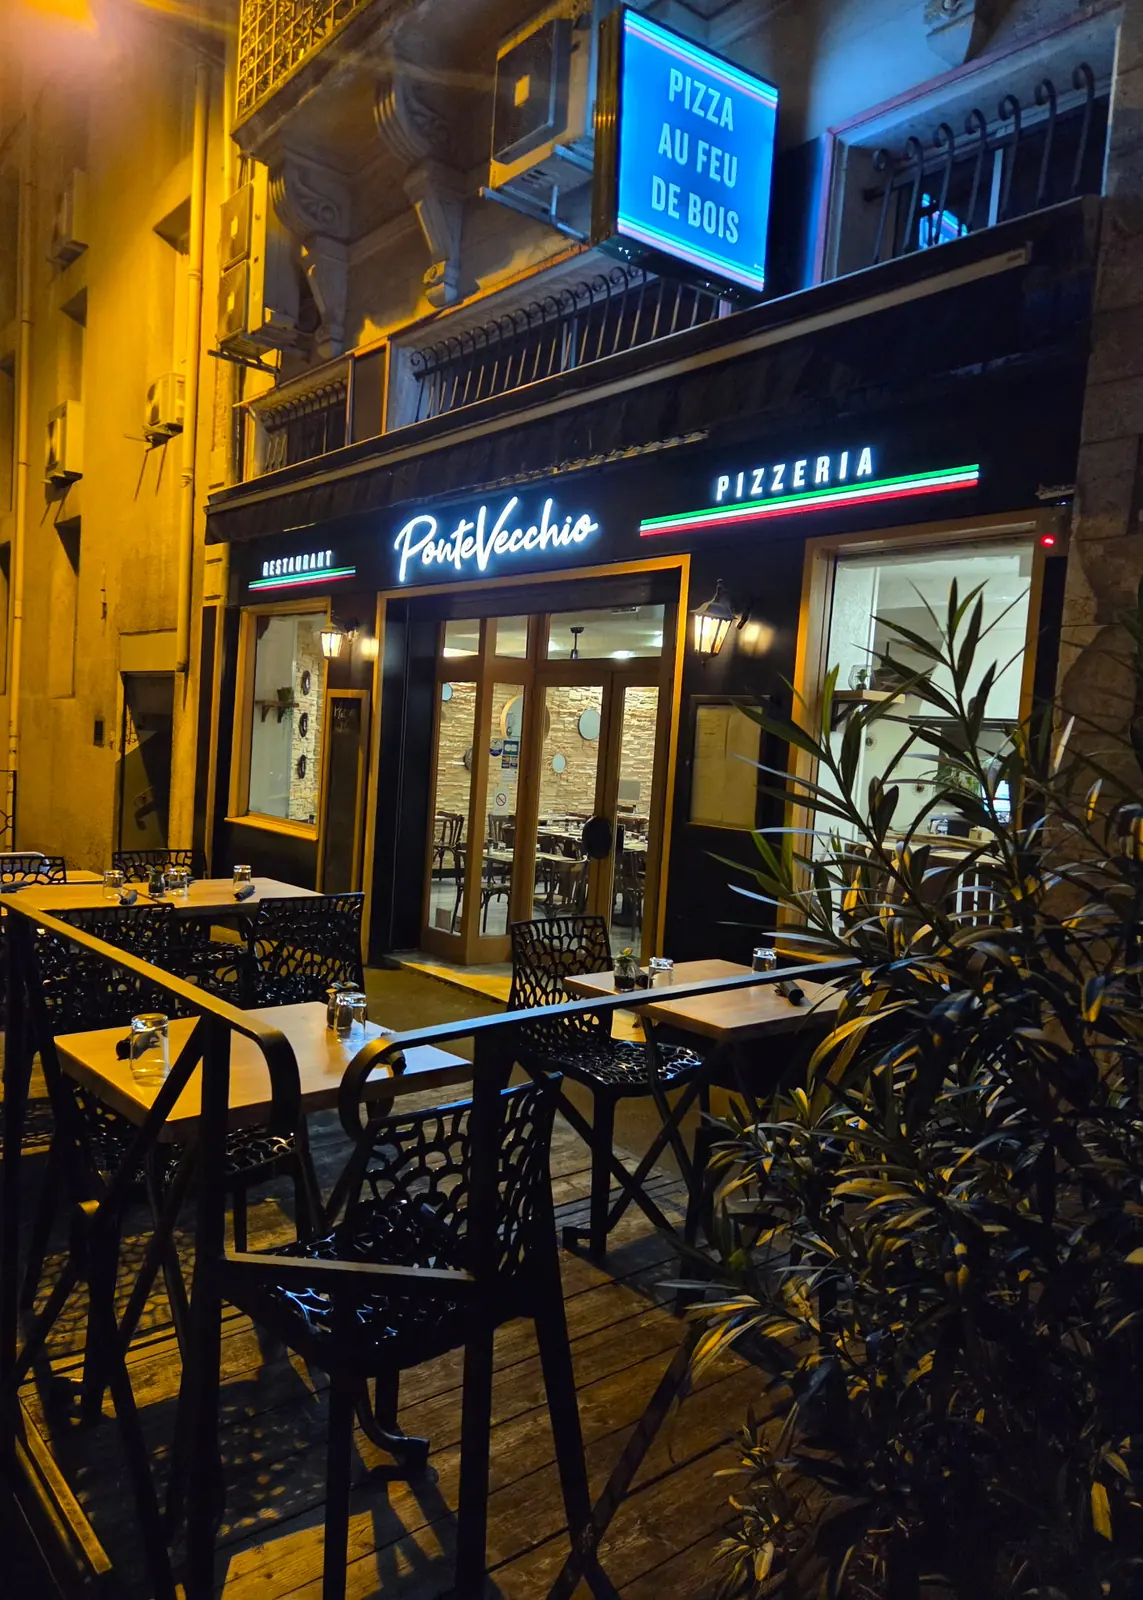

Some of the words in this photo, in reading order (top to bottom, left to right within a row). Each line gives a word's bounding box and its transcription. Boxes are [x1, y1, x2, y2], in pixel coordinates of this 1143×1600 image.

[669, 68, 734, 131] PIZZA
[658, 122, 689, 165] AU
[696, 140, 737, 188] FEU
[651, 175, 681, 220] DE
[688, 192, 739, 244] BOIS
[716, 447, 873, 501] PIZZERIA
[262, 550, 332, 577] RESTAURANT
